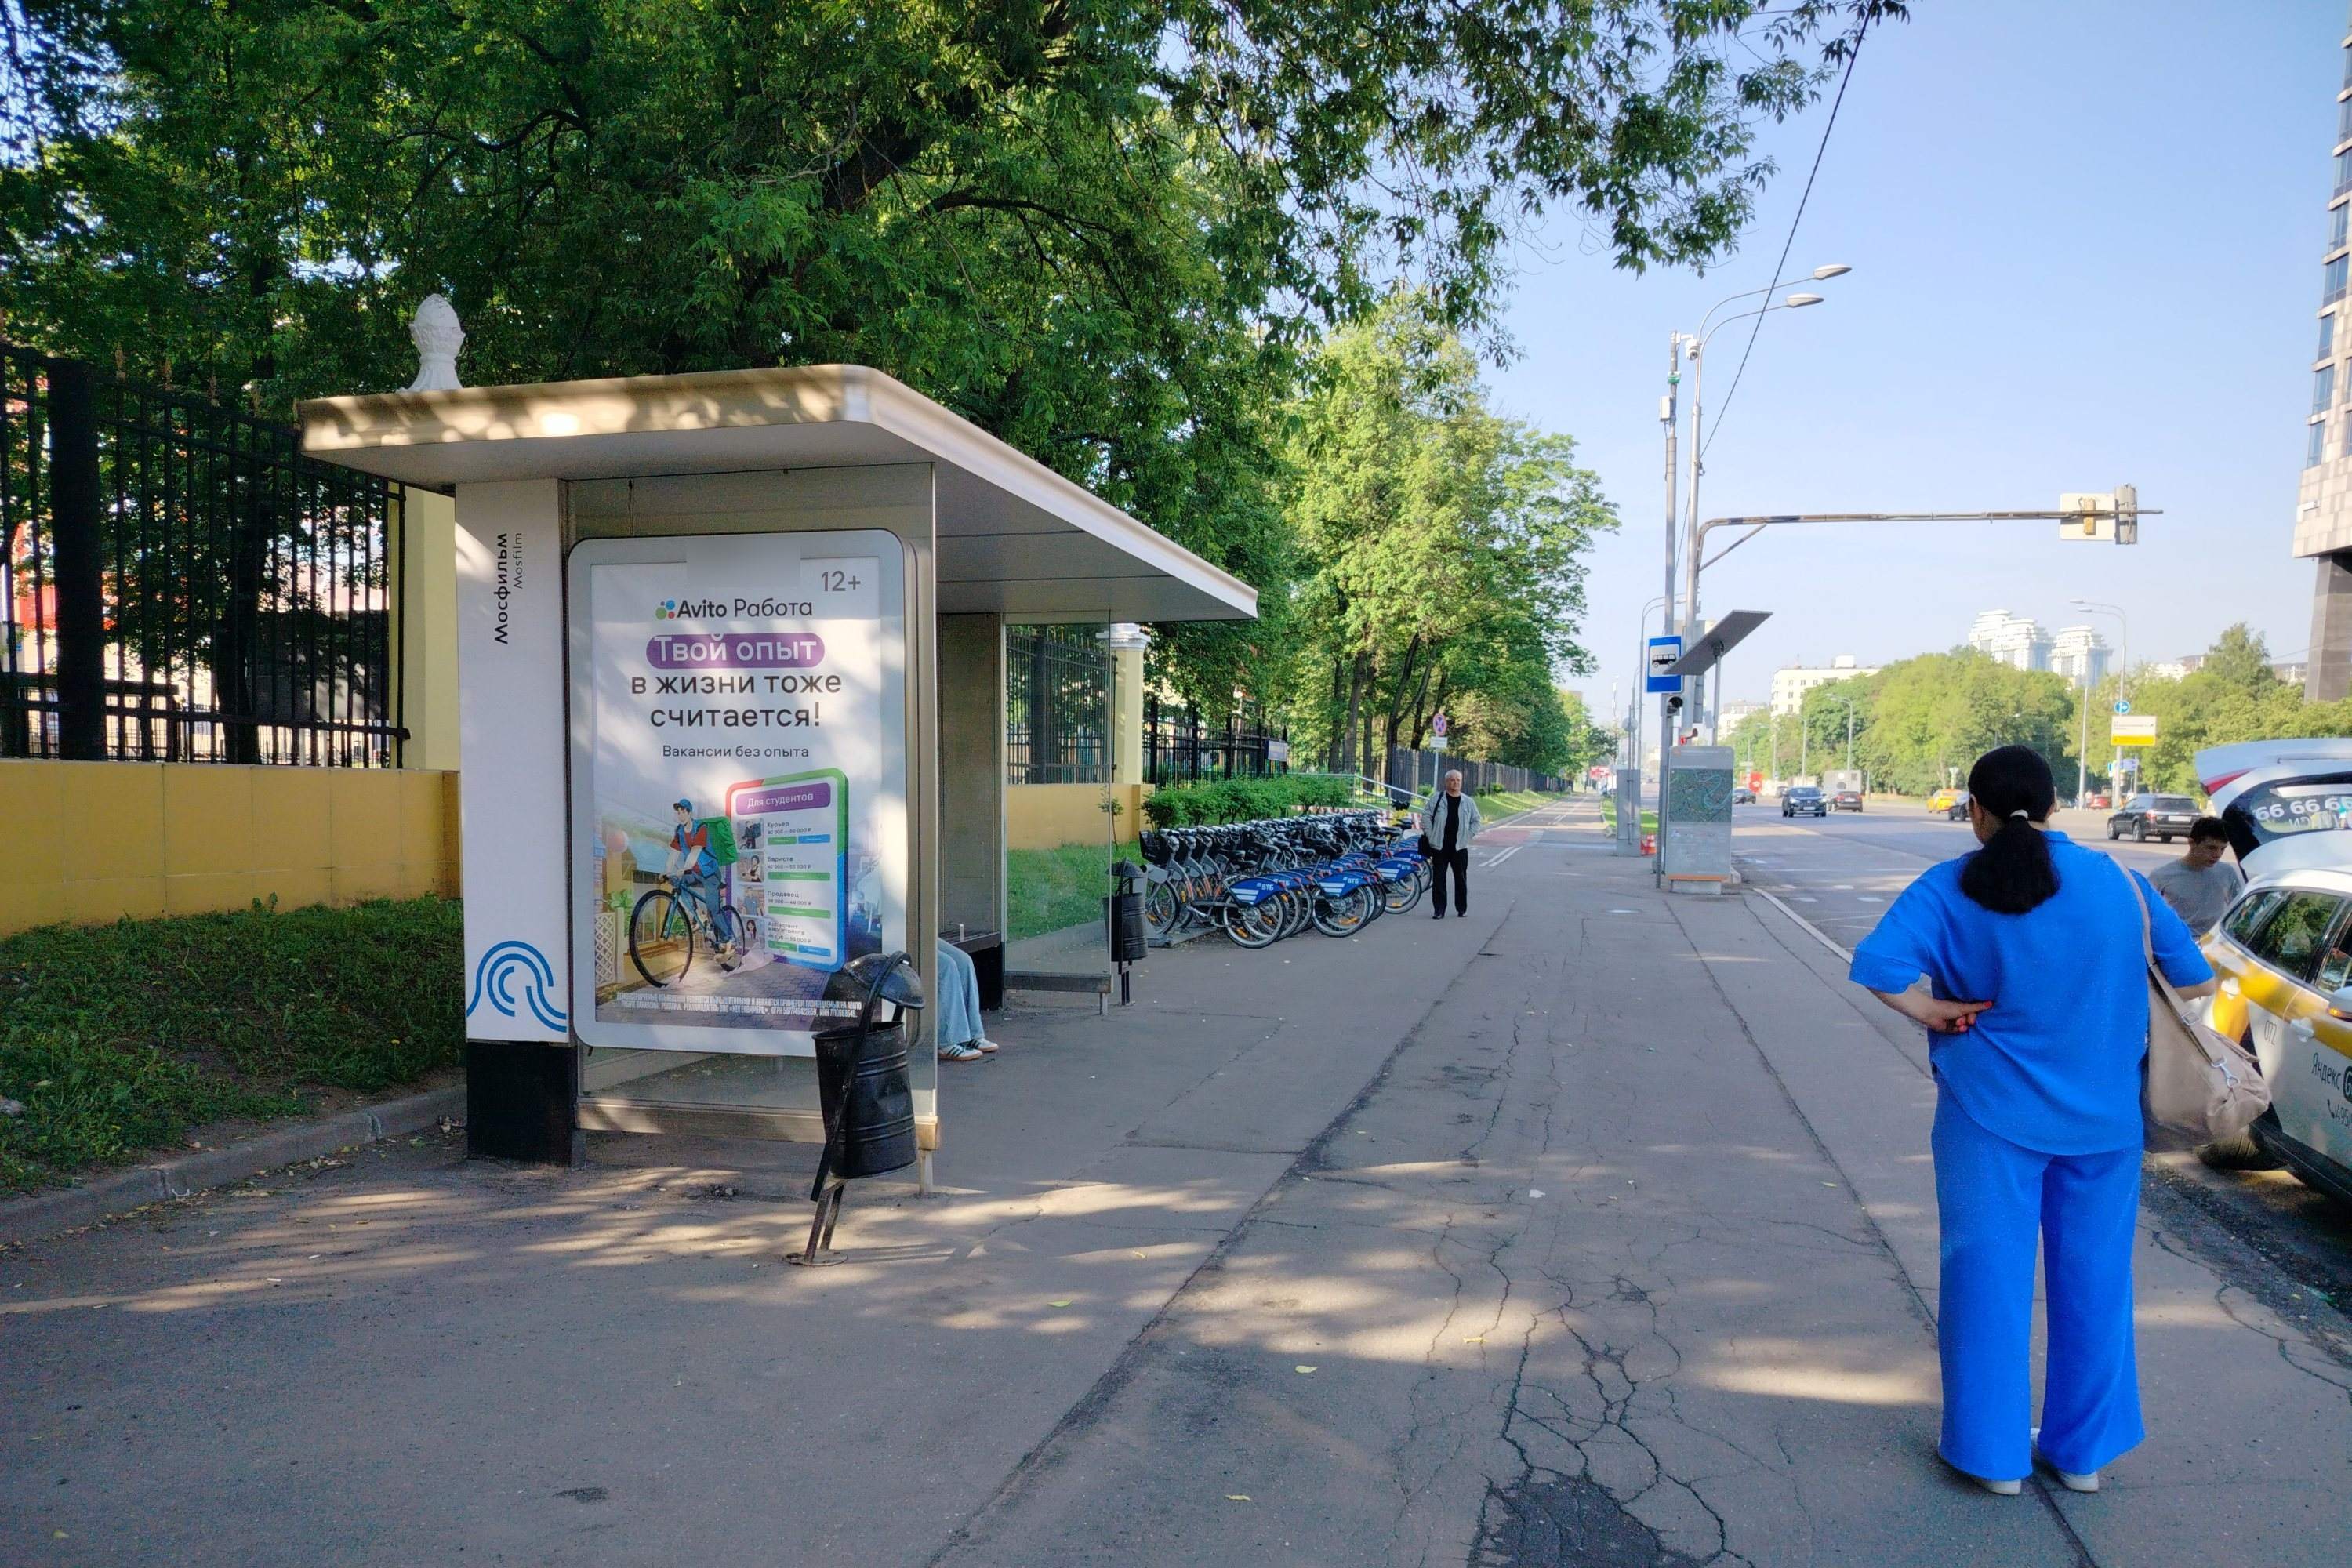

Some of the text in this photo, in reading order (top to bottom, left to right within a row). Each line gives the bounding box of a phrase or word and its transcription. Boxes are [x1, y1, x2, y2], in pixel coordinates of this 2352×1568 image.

[513, 533, 523, 589] Mosfilm
[494, 533, 510, 644] Мосфильм
[821, 571, 861, 592] 12+
[677, 597, 813, 619] Avito Работа
[654, 633, 817, 662] Твой опыт
[632, 673, 842, 695] в жизни тоже
[650, 702, 821, 728] считается!
[662, 744, 809, 758] Вакансии без опыта
[747, 793, 814, 808] Для студентов
[2312, 1052, 2342, 1091] Яндекс
